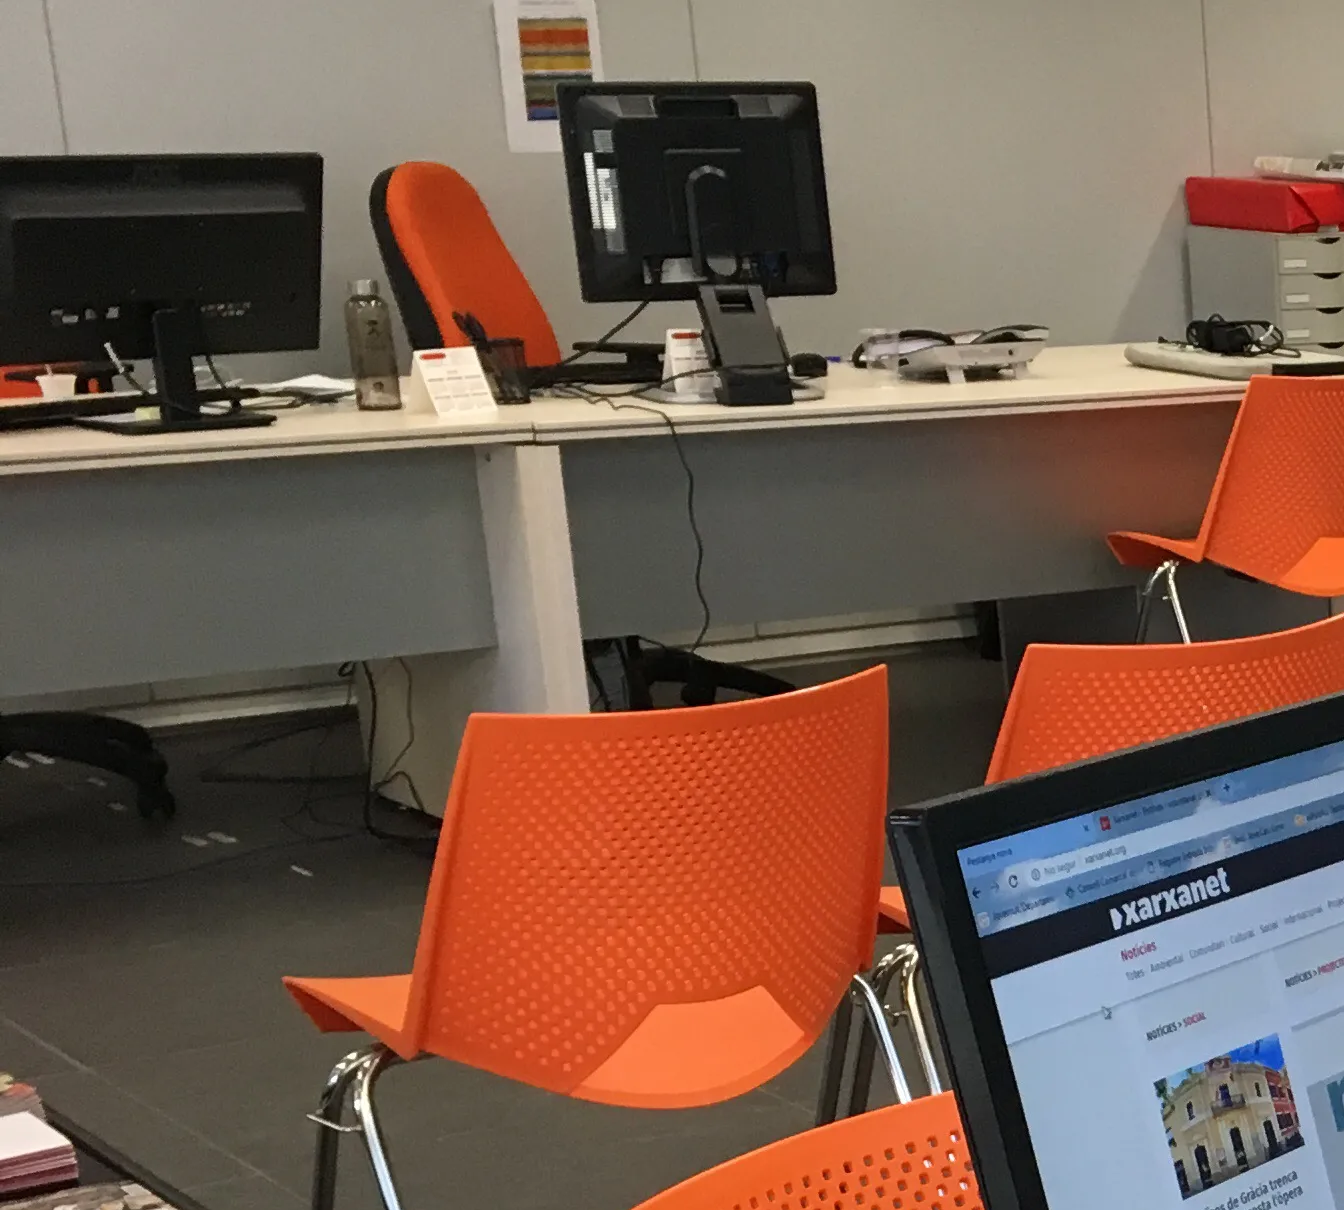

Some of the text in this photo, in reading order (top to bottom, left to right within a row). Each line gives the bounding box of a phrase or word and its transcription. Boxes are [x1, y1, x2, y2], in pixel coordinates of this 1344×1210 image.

[1119, 866, 1231, 927] xarxanet
[1119, 938, 1157, 963] Notícies
[1182, 1010, 1207, 1028] SOCIAL
[1239, 1180, 1269, 1205] Gràcia
[1268, 1168, 1298, 1192] trenca
